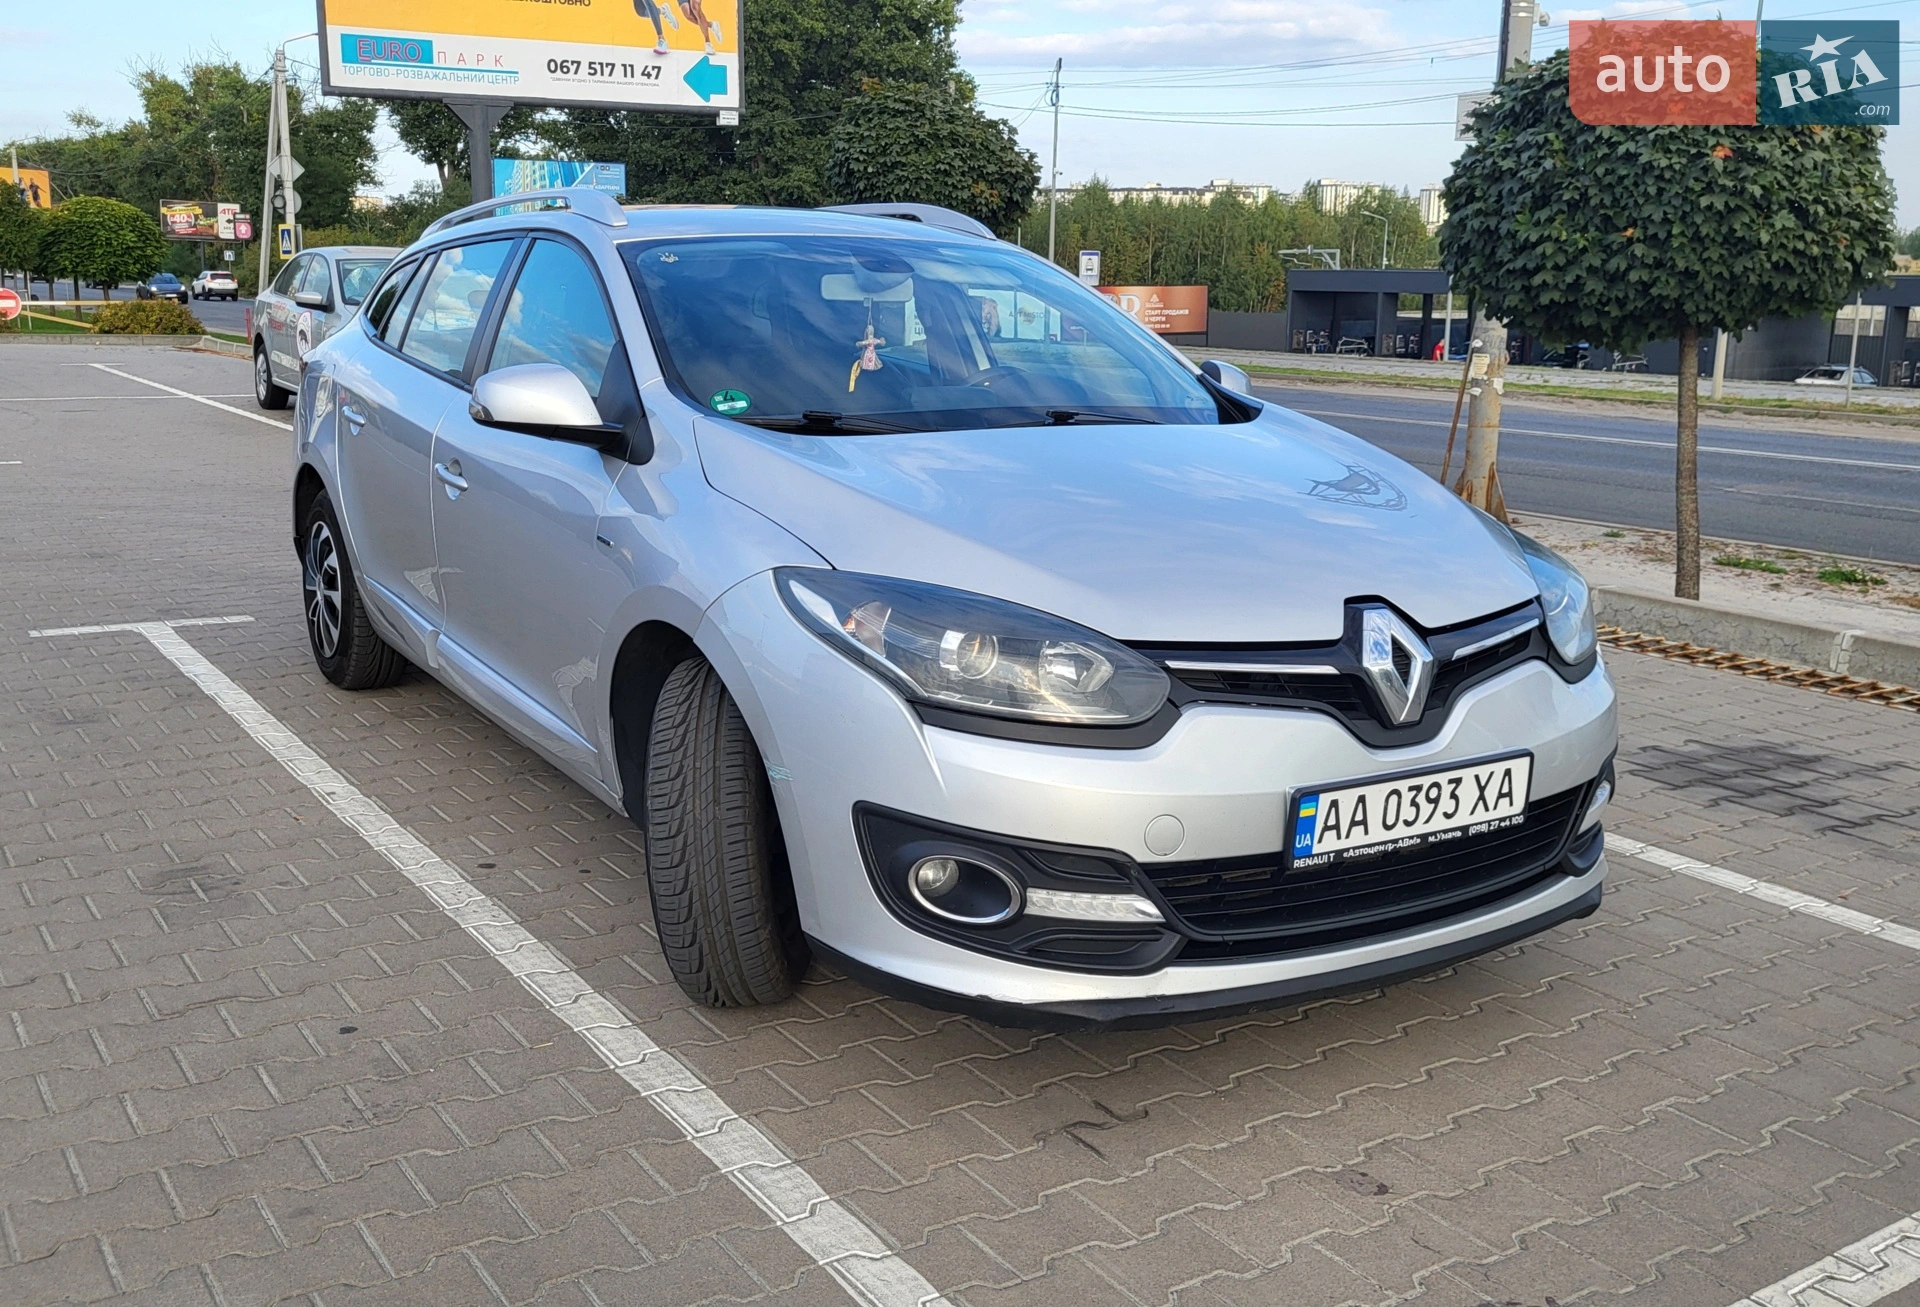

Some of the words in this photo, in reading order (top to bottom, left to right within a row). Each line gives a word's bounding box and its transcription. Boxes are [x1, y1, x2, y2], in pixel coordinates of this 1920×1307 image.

[356, 38, 422, 63] EURO
[437, 51, 504, 68] ПАРК
[341, 65, 486, 83] ТОРГОВО-РОЗВАЖАЛЬНИЙ
[487, 75, 520, 86] ЦЕНТР
[547, 58, 582, 75] 067
[587, 61, 616, 77] 517
[621, 63, 635, 79] 11
[640, 65, 662, 80] 47
[724, 391, 735, 402] 4
[1316, 794, 1370, 845] AA
[1381, 776, 1463, 832] 0393
[1468, 767, 1514, 817] XA
[1295, 832, 1312, 848] UA
